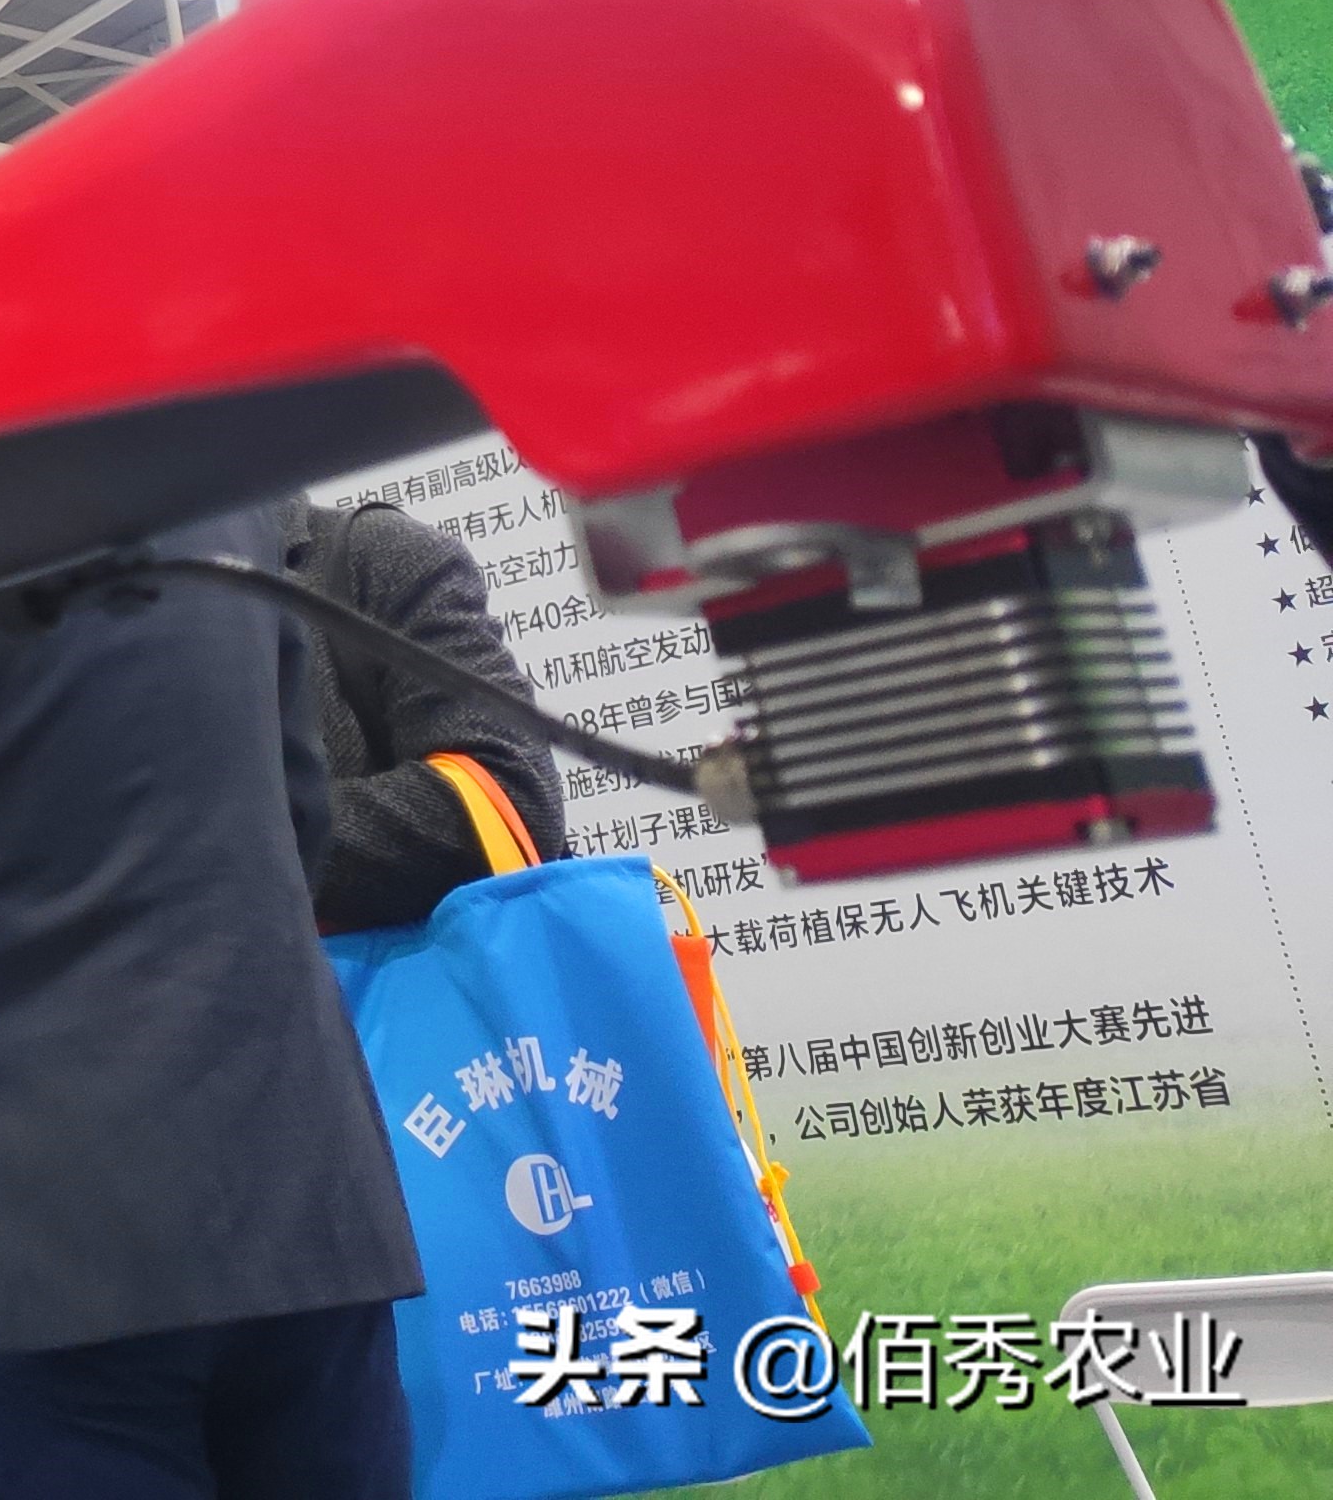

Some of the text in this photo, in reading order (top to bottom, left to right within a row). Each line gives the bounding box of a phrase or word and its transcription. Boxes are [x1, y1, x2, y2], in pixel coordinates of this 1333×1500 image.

[492, 593, 607, 643] 作40余
[676, 855, 1176, 960] 大载荷植保无人飞机关键技术
[505, 1269, 582, 1300] 7663988
